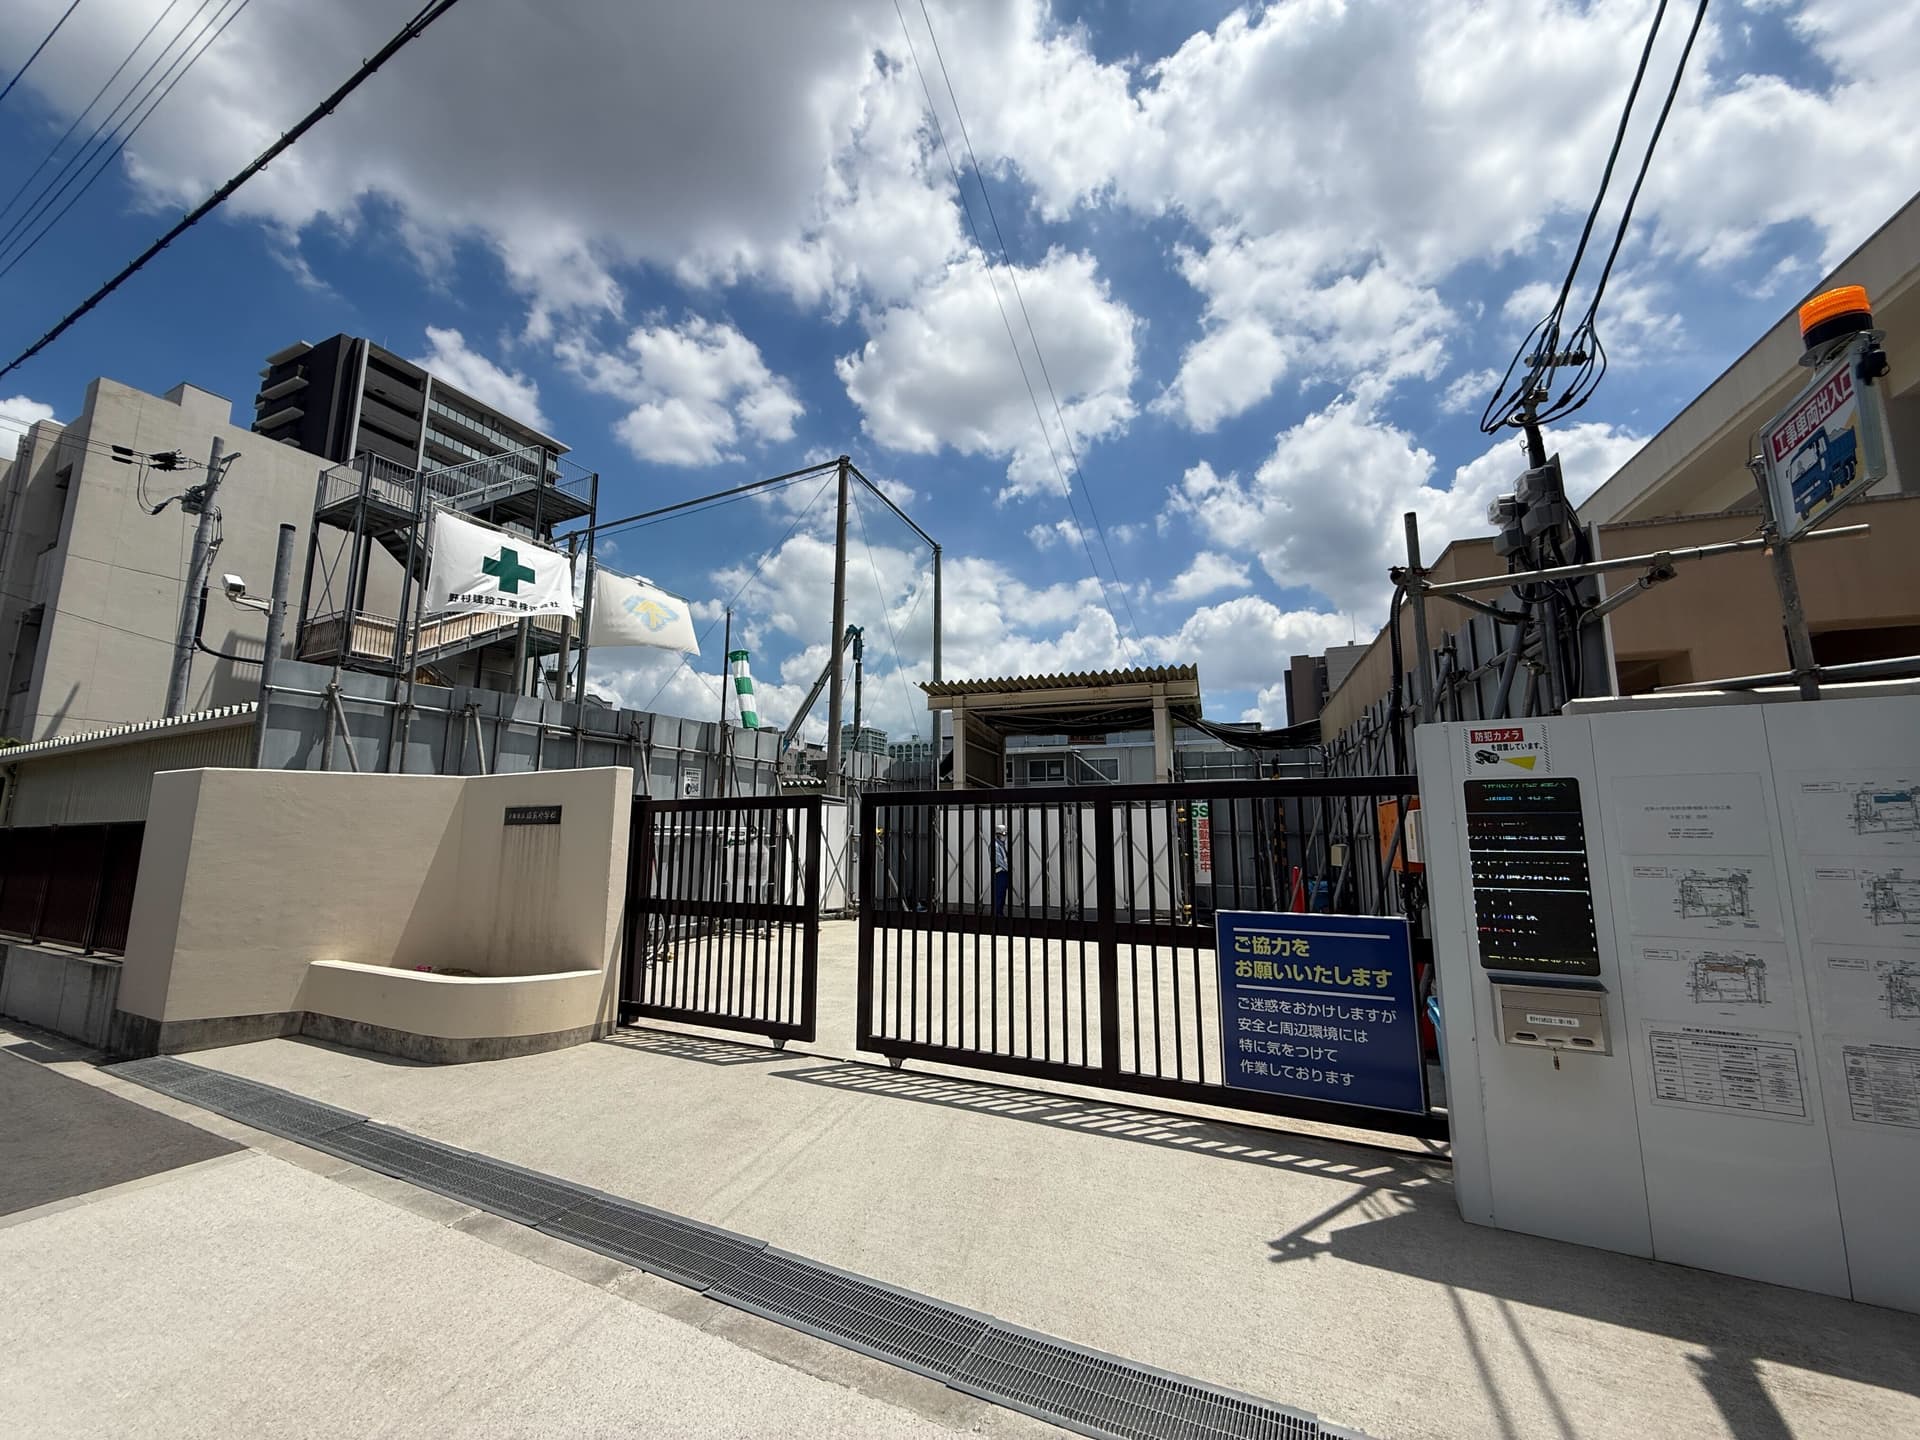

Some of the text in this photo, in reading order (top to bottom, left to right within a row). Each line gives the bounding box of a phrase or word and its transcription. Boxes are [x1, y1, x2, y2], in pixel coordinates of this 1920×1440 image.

[1775, 371, 1853, 457] 工事車両出入口
[1474, 730, 1520, 742] 防犯カメラ
[1191, 805, 1208, 818] 5S
[1234, 935, 1310, 957] ご協力を
[1235, 960, 1392, 988] お願いいたします
[1237, 997, 1397, 1024] ご迷惑をおかけしますが
[1238, 1017, 1368, 1043] 安全と周辺環境には
[1239, 1038, 1338, 1062] 特に気をつけて
[1240, 1059, 1355, 1086] 作業しております
